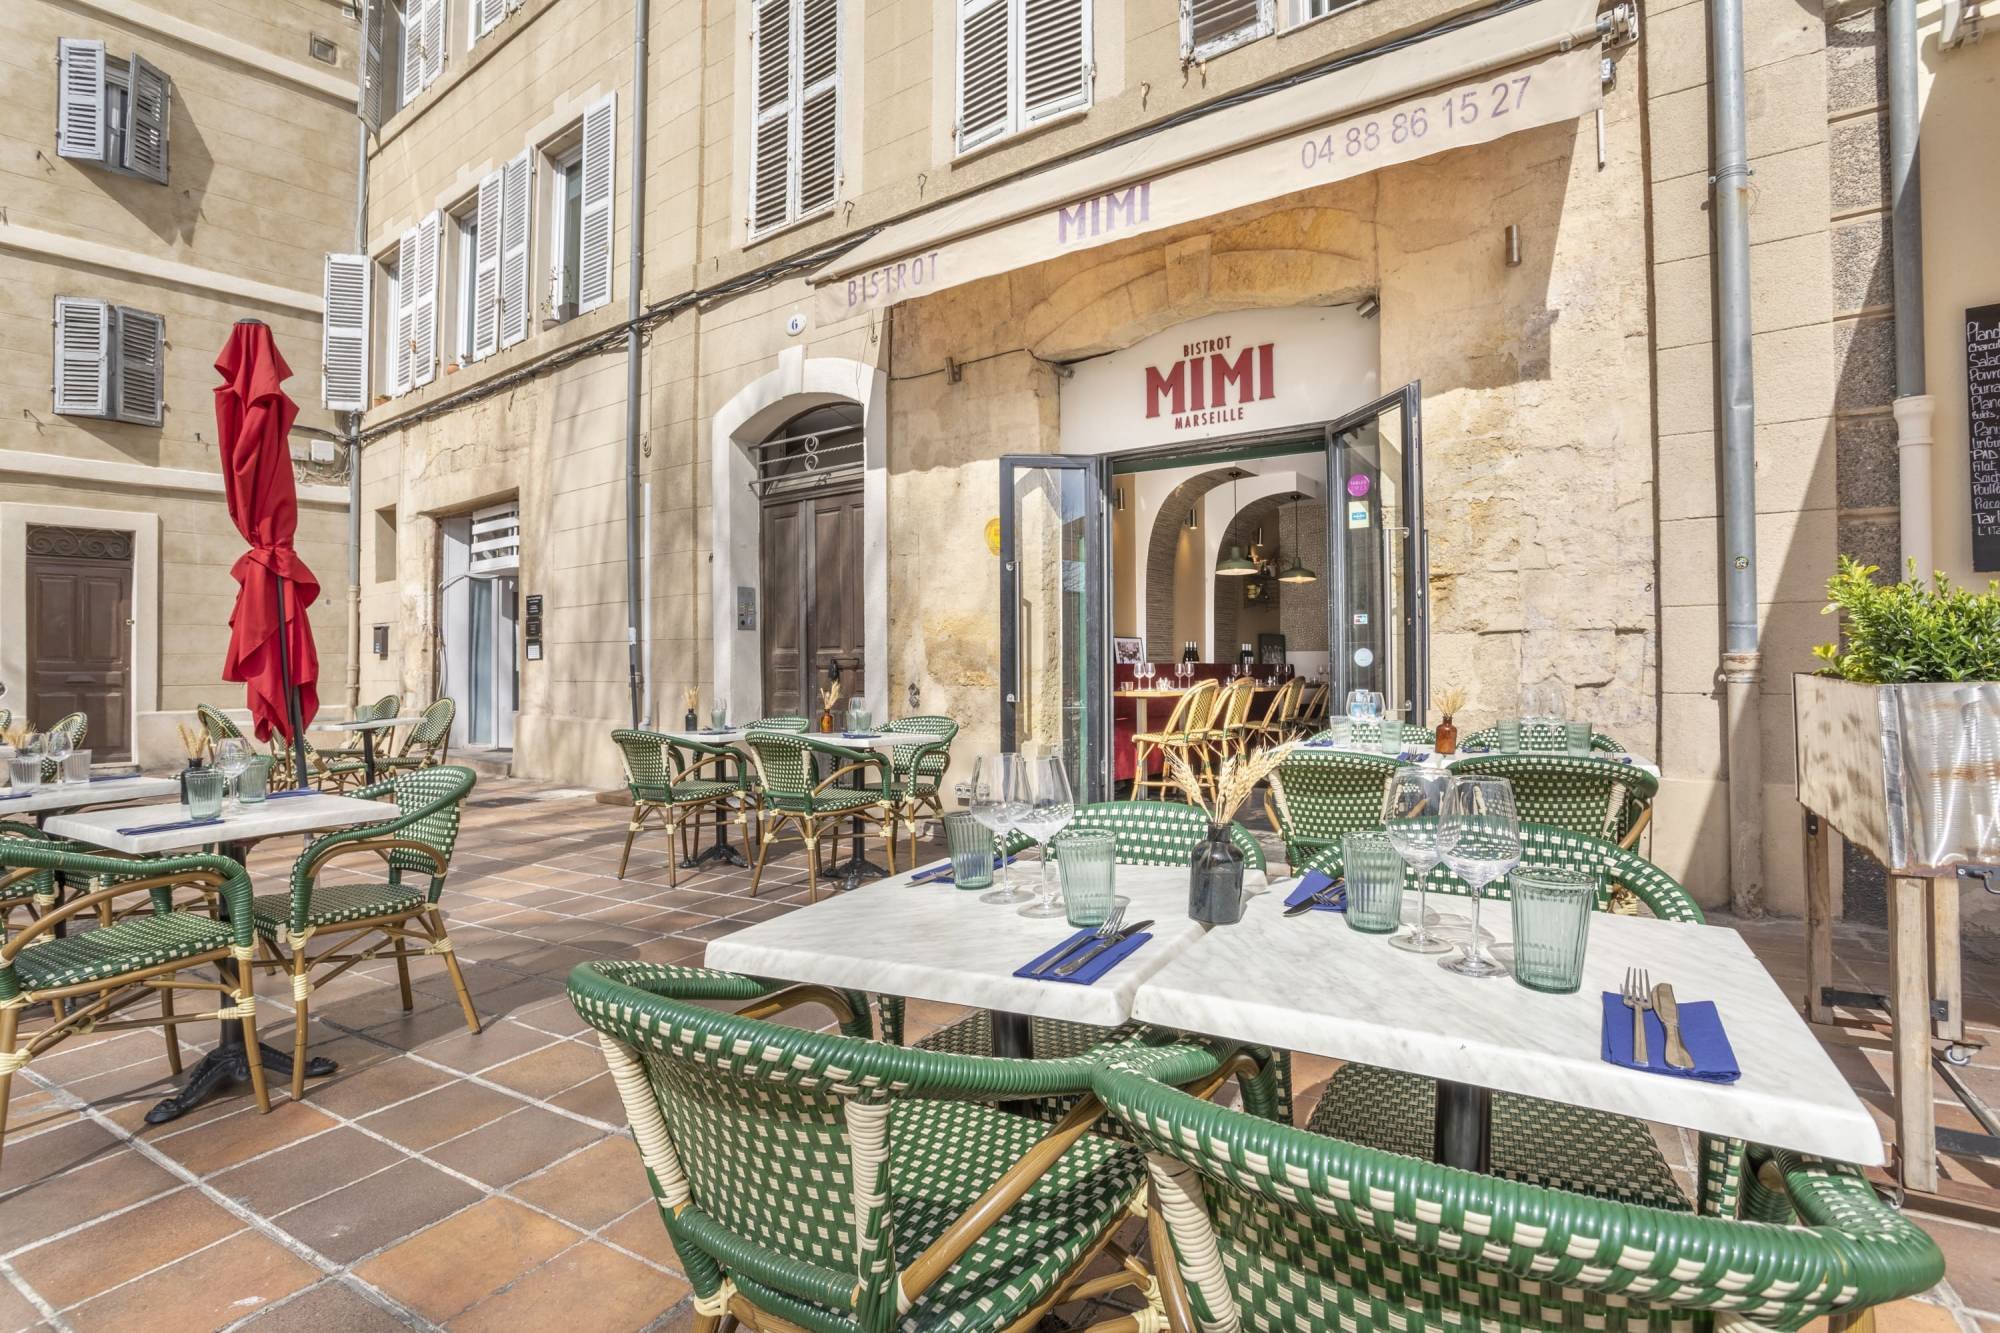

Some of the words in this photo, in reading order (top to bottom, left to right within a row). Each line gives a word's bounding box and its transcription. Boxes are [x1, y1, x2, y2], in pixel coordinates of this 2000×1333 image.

[1301, 134, 1334, 170] 04
[1345, 121, 1381, 157] 88
[1391, 107, 1429, 144] 86
[1442, 91, 1479, 128] 15
[1490, 75, 1531, 119] 27
[1058, 182, 1150, 244] MIMI
[847, 252, 938, 308] BISTROT
[791, 318, 798, 331] 6
[1183, 335, 1232, 358] BISTROT
[1145, 343, 1275, 419] MIMI
[1174, 407, 1244, 430] MARSEILLE
